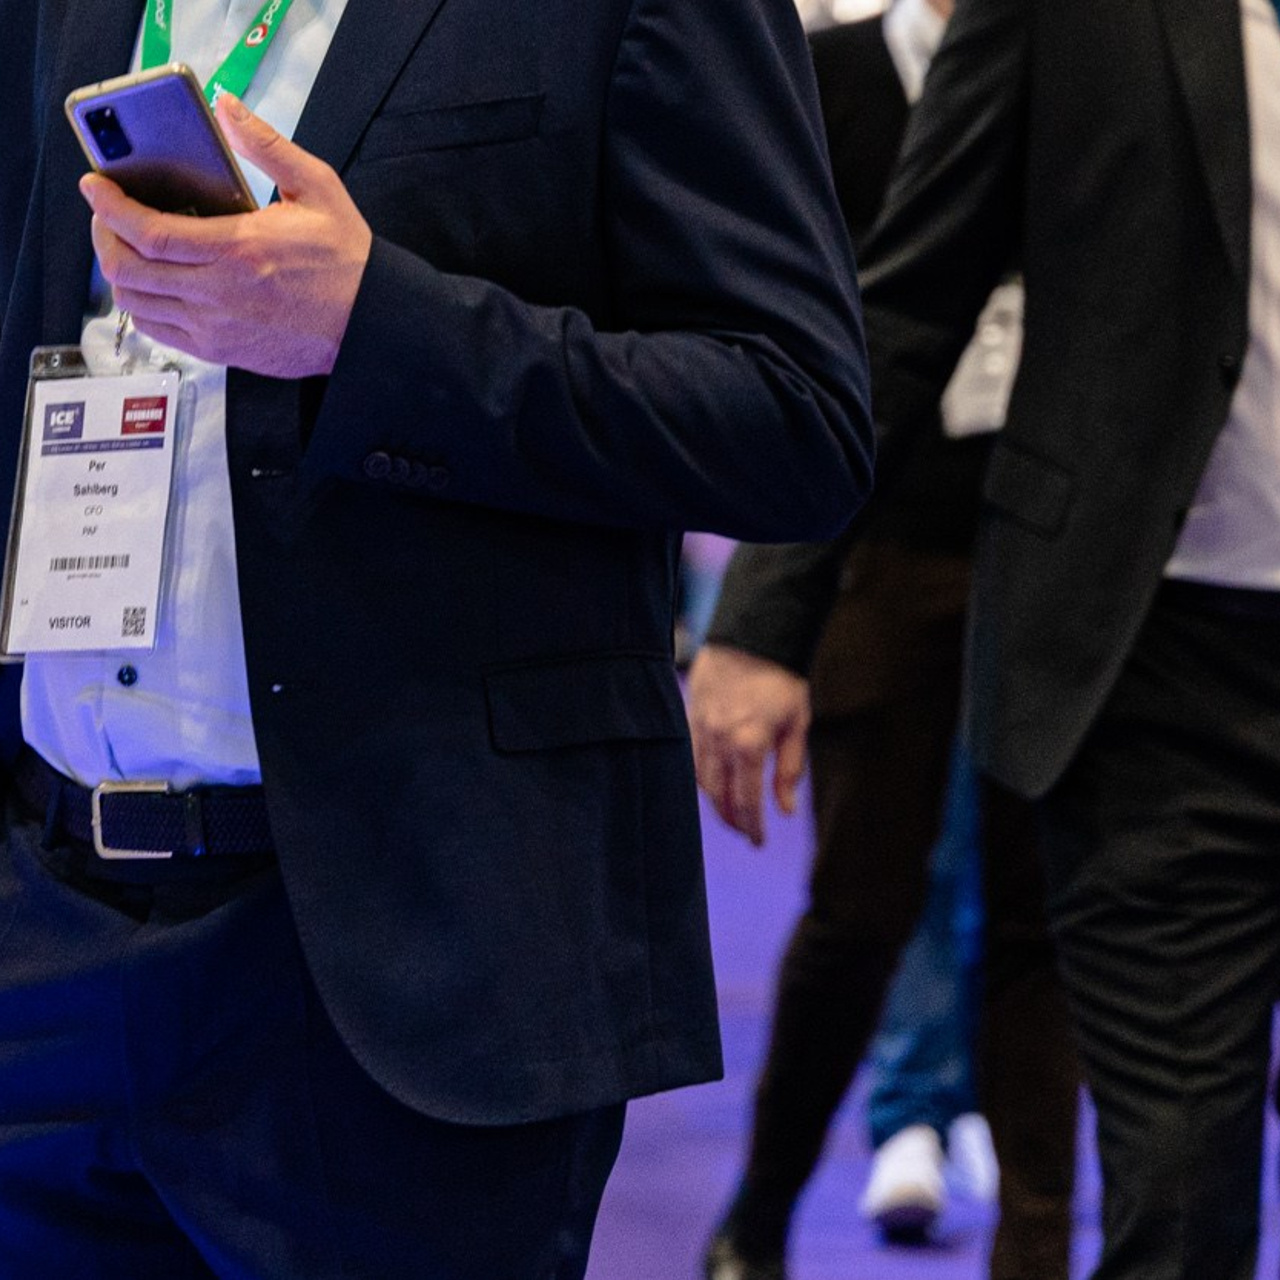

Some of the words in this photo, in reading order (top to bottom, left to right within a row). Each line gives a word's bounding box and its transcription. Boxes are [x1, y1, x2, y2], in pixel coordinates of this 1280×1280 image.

[49, 409, 75, 426] ICE
[88, 459, 107, 472] Per
[73, 483, 119, 497] Sahlberg
[49, 616, 91, 630] VISITOR
